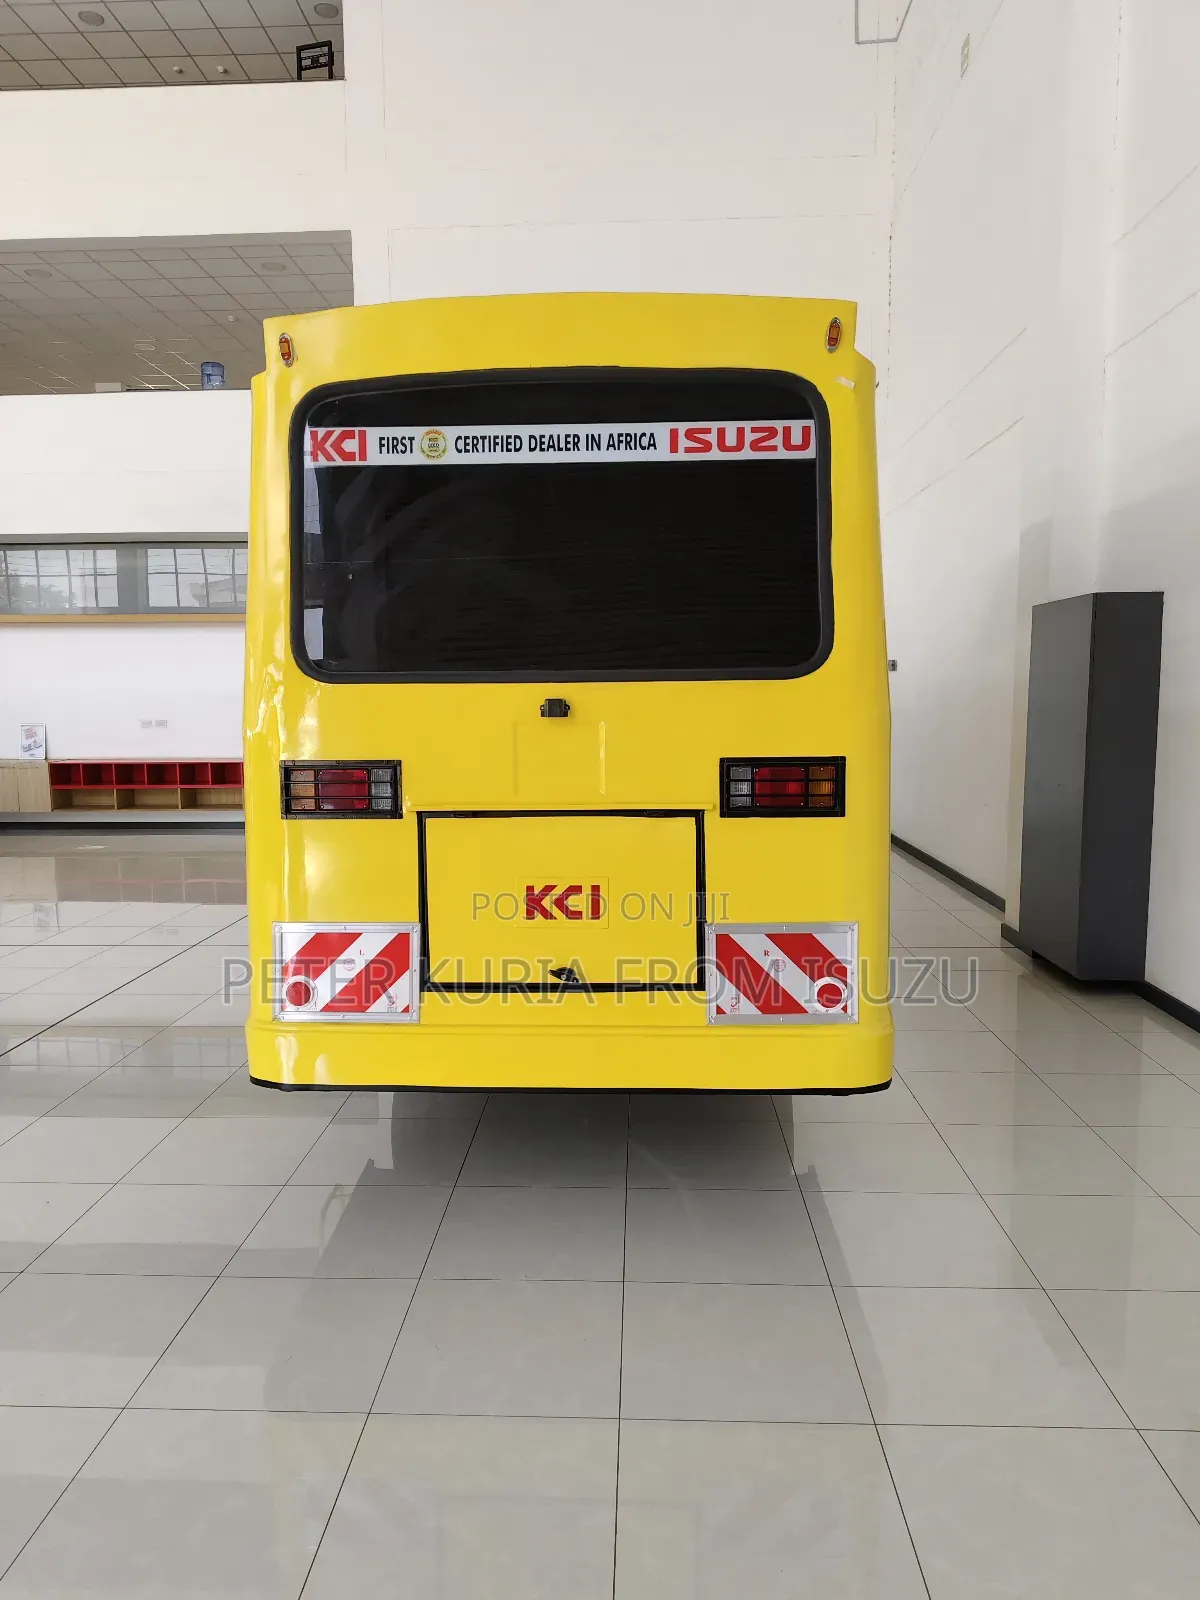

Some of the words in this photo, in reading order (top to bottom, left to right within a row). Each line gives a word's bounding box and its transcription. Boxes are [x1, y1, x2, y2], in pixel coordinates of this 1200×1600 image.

[310, 430, 367, 462] KCI
[378, 436, 416, 455] FIRST
[454, 434, 523, 454] CERTIFIED
[528, 434, 581, 453] DEALER
[585, 434, 602, 452] IN
[606, 432, 658, 451] AFRICA
[669, 425, 812, 454] ISUZU
[525, 884, 601, 920] KCI
[763, 949, 770, 957] R
